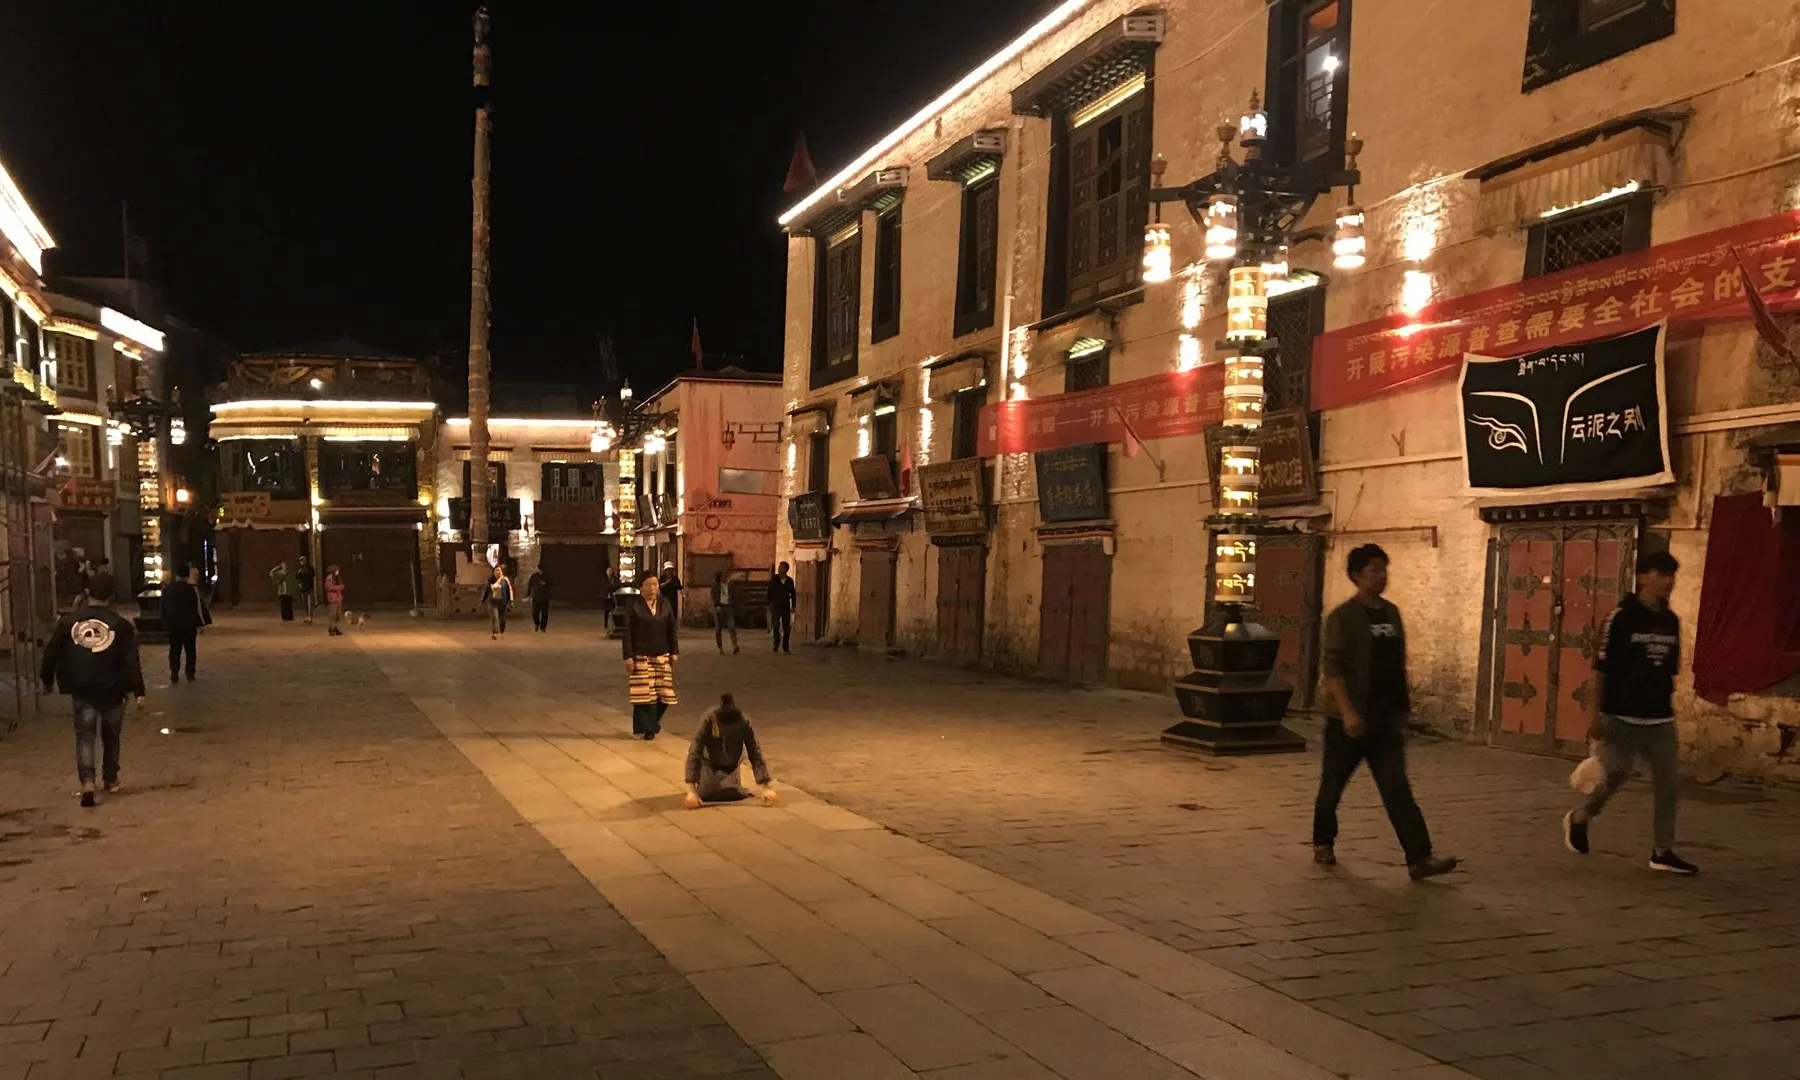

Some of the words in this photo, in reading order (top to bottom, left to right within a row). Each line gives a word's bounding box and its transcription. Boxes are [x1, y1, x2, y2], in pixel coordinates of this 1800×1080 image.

[1347, 256, 1797, 382] 开展污染源普查需要全社会的支
[1571, 404, 1645, 443] 云泥之别
